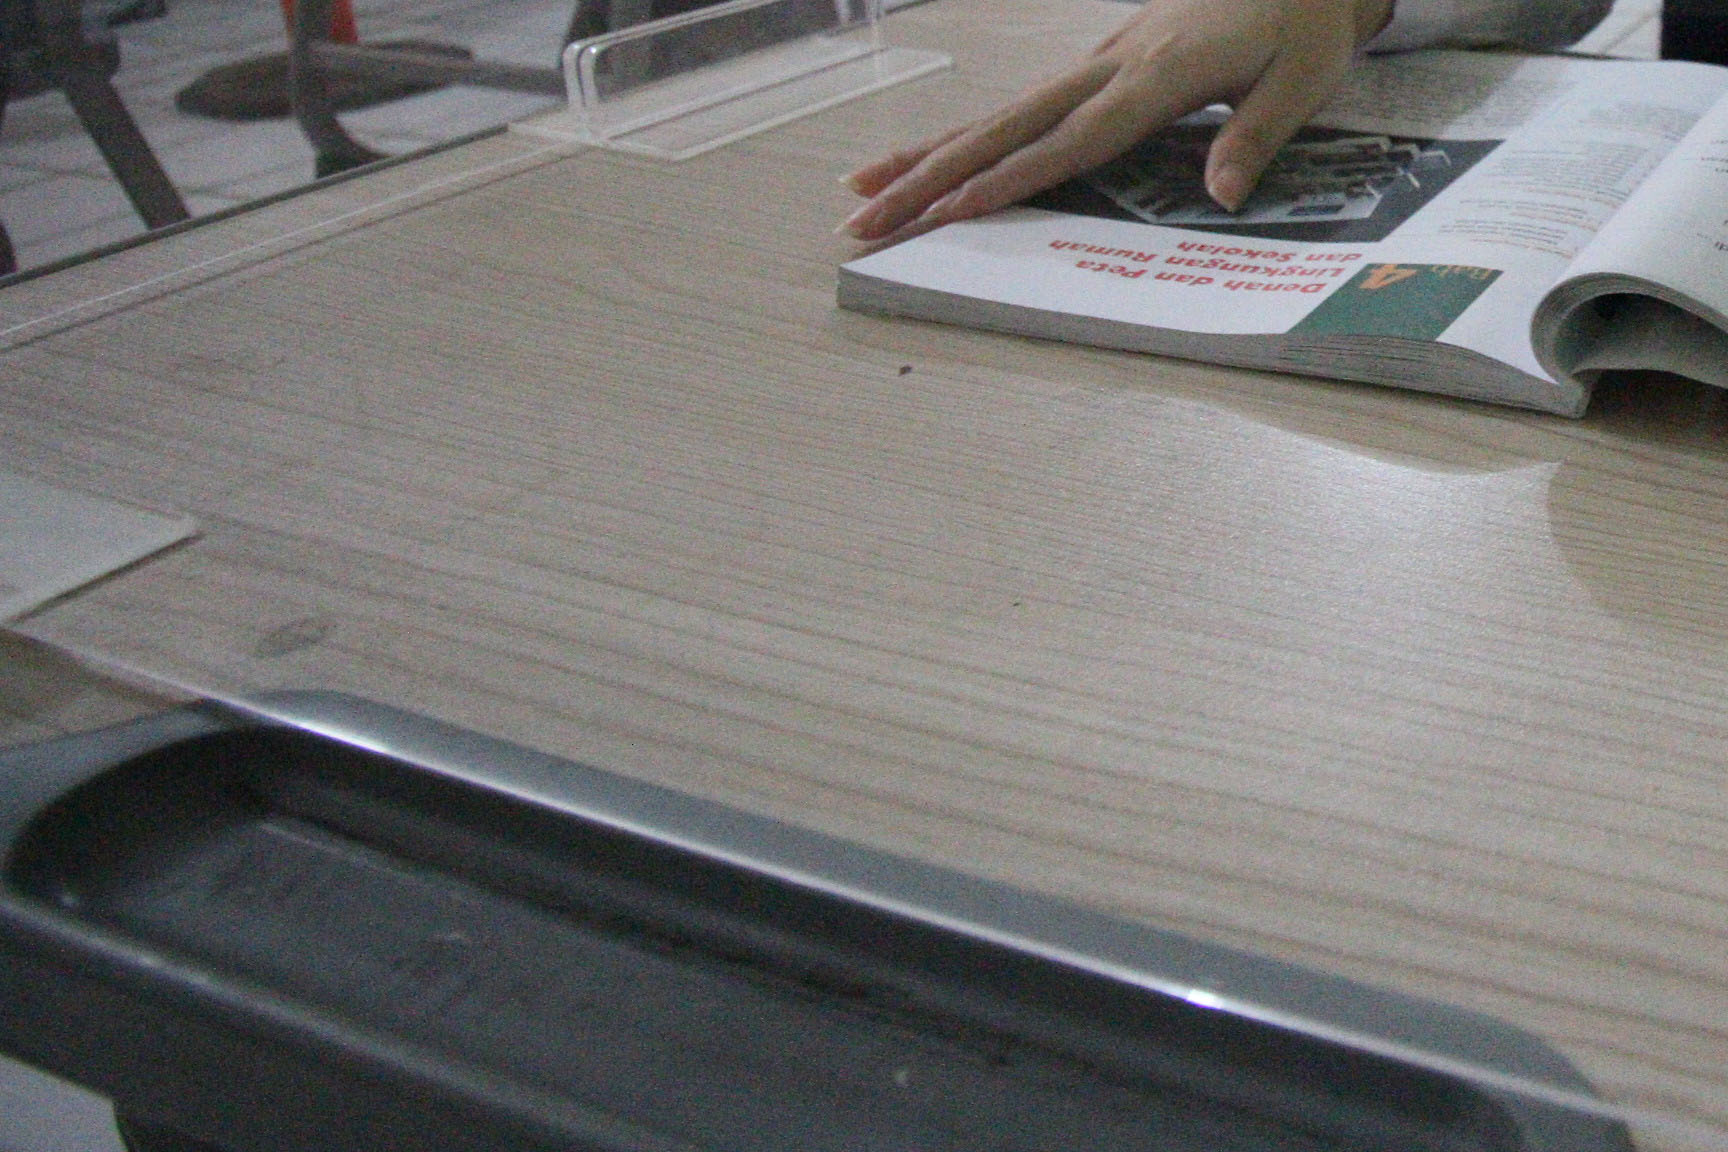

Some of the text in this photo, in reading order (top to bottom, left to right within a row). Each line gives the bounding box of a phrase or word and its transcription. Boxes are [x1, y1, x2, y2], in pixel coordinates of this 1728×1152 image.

[1048, 239, 1346, 279] Lingkungan Rumah
[1176, 241, 1363, 263] dan Sekolah
[1074, 260, 1327, 294] Denah dan Peta
[1359, 264, 1418, 290] 4
